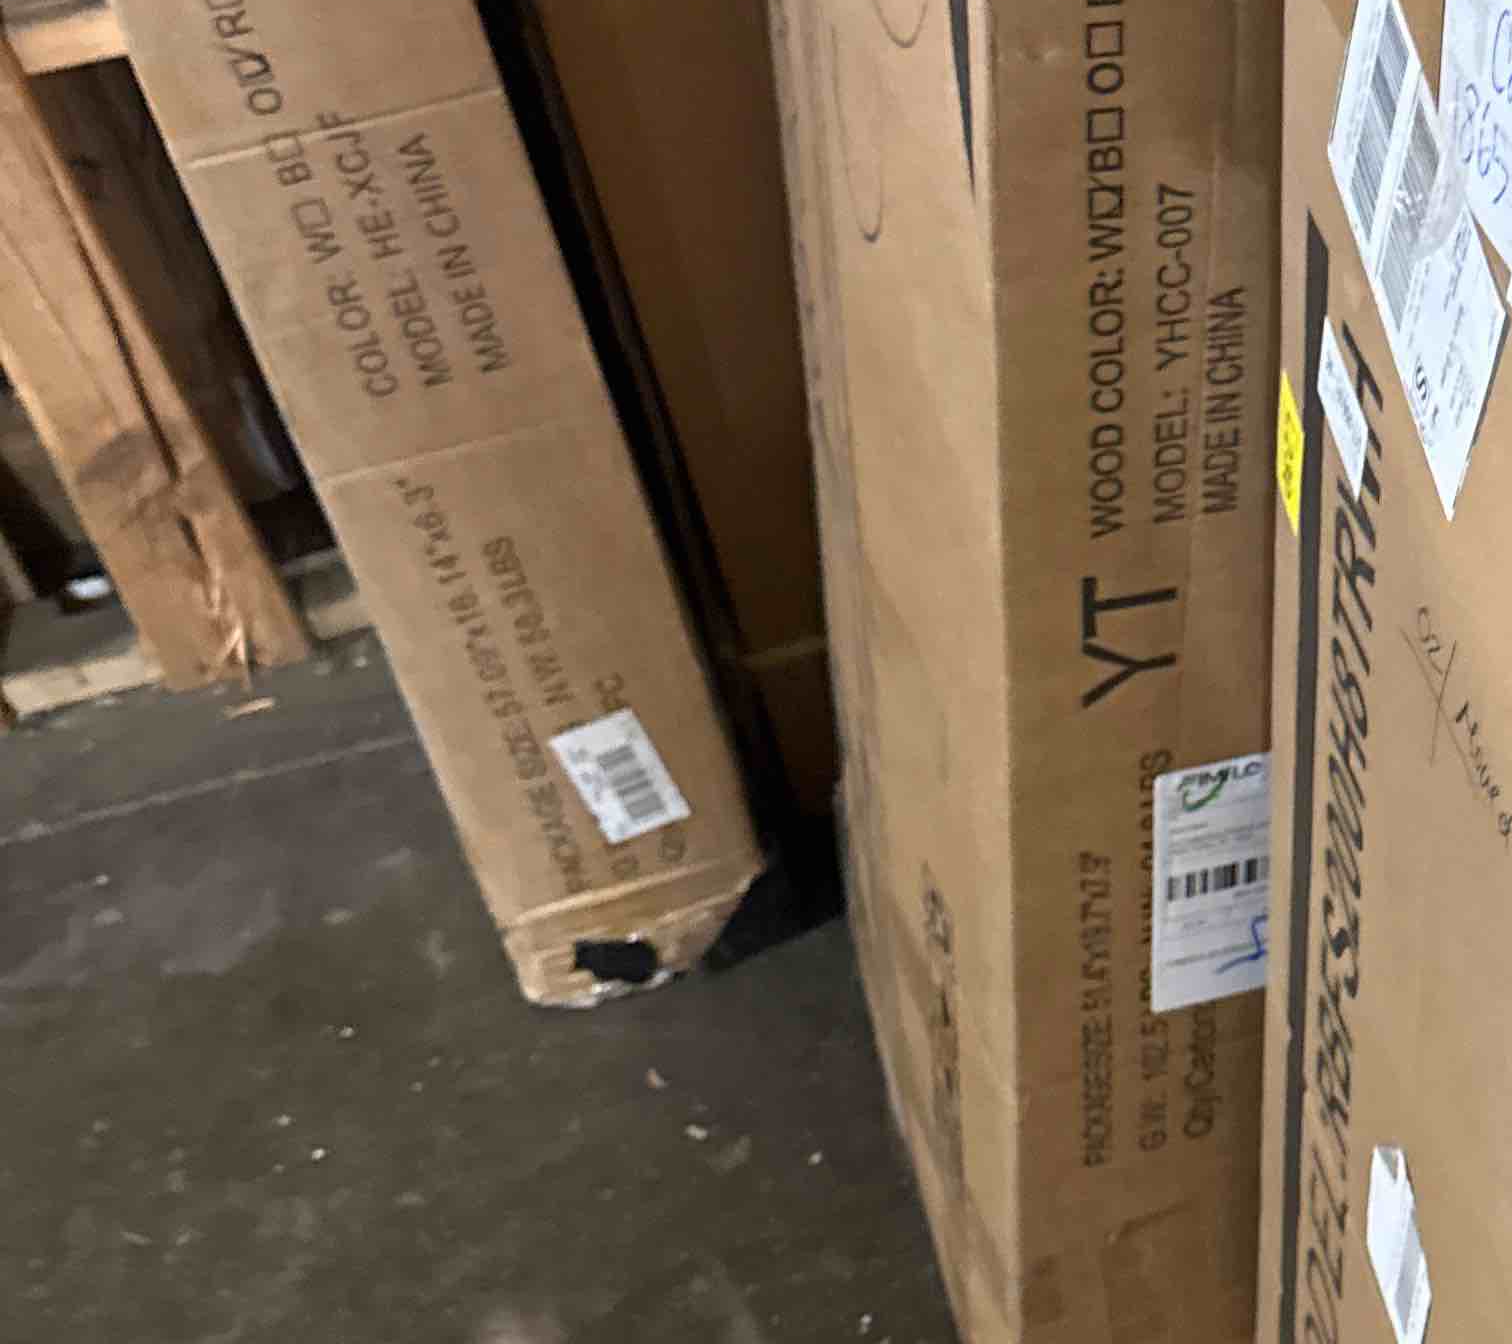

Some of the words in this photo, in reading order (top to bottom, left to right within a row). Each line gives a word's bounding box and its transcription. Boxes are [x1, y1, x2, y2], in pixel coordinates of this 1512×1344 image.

[393, 130, 461, 240] CHINA
[437, 247, 475, 279] IN
[1155, 182, 1196, 372] YHCC-007
[446, 284, 511, 377] MADE
[1089, 266, 1126, 415] COLOR:
[1205, 284, 1247, 385] CHINA
[1153, 387, 1190, 527] MODEL:
[1214, 391, 1242, 422] IN
[1089, 423, 1126, 539] WOOD
[1203, 426, 1240, 516] MADE
[1080, 574, 1180, 709] YT
